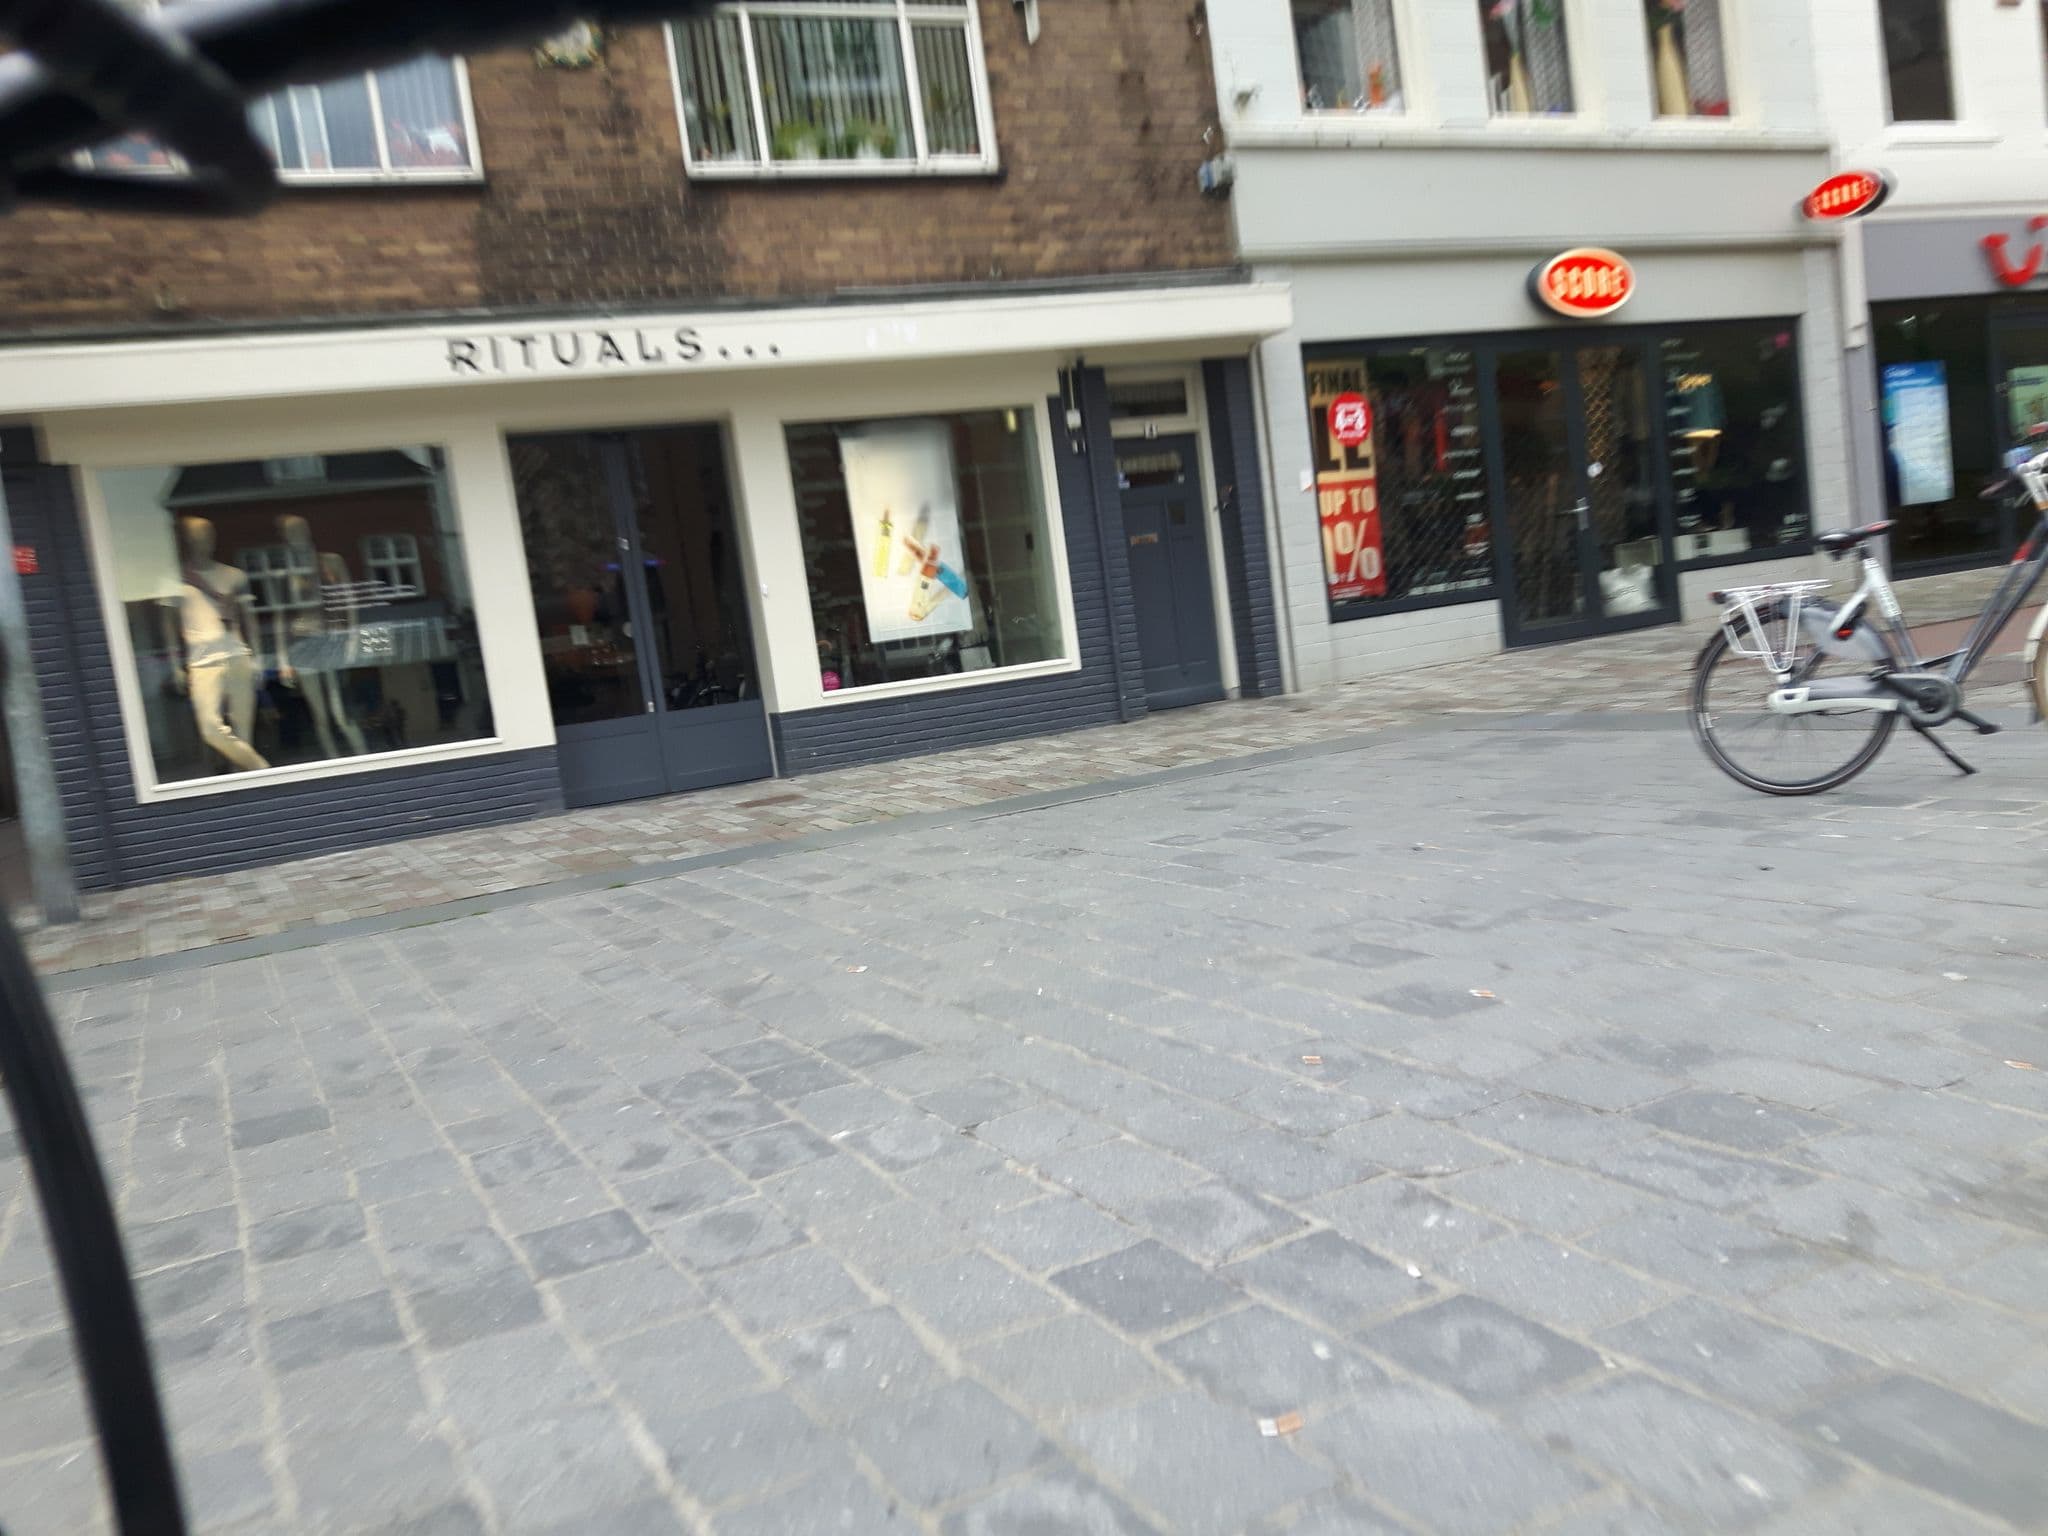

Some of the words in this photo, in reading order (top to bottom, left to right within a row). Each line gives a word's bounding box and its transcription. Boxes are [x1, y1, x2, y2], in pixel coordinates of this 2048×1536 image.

[1550, 265, 1625, 300] SCORE
[1318, 488, 1346, 517] UP
[1349, 485, 1377, 513] TO
